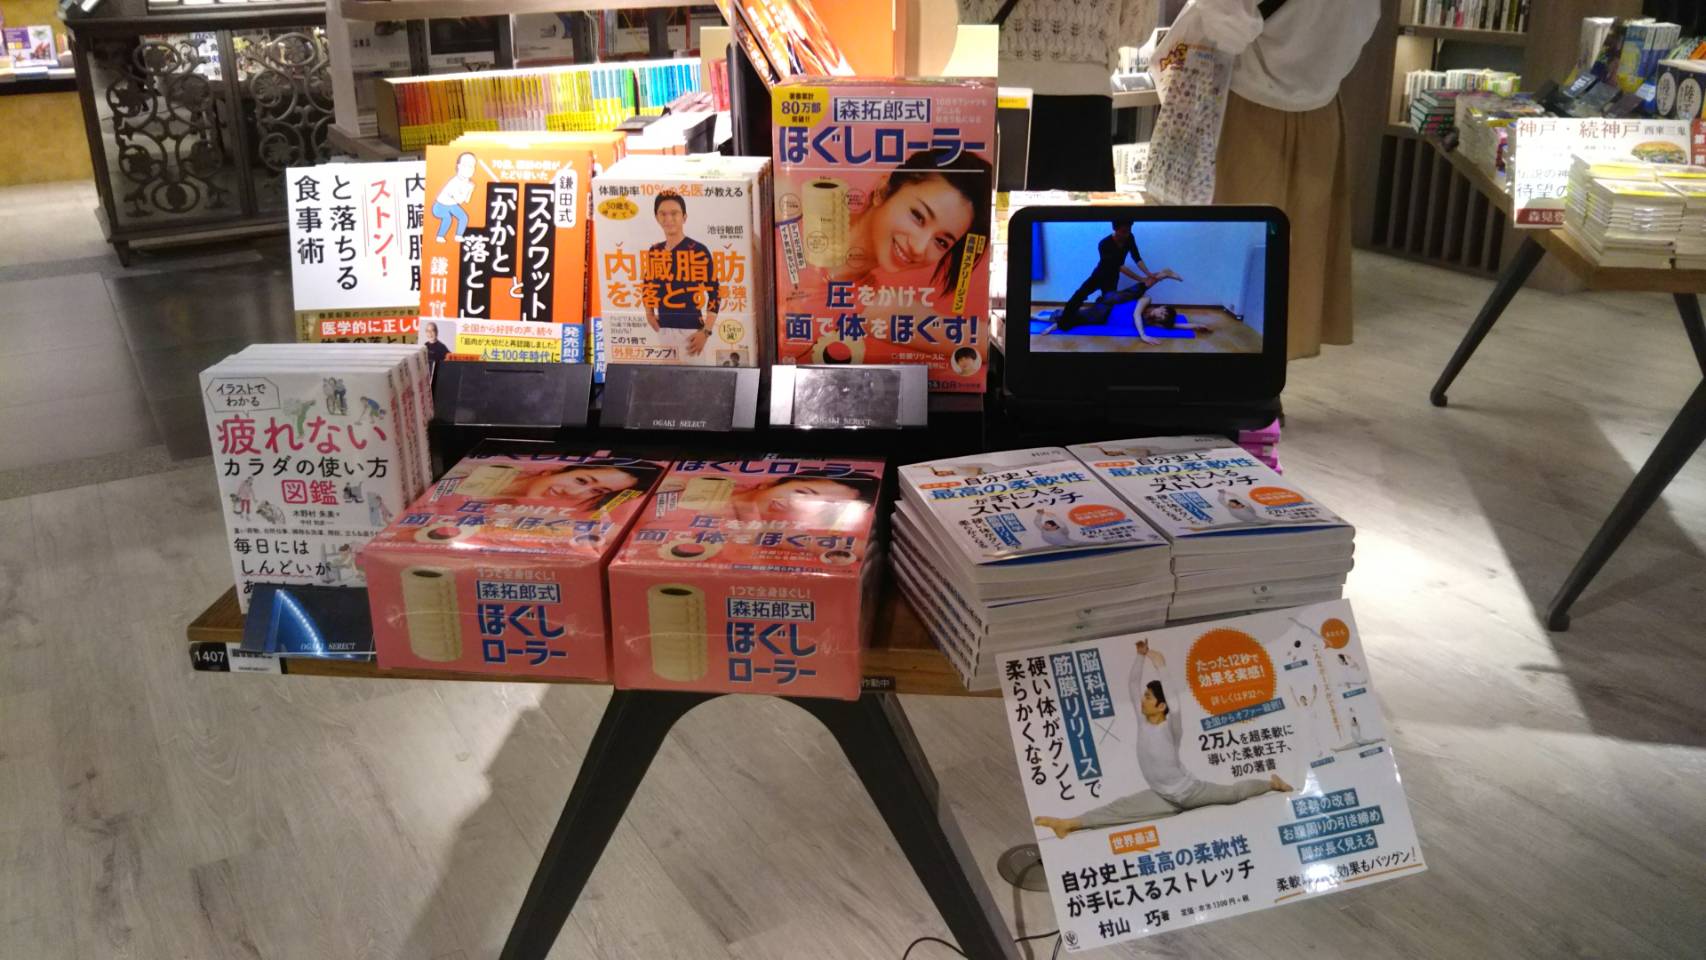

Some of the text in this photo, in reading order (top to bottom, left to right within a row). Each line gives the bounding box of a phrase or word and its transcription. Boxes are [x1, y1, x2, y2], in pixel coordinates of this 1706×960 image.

[781, 101, 821, 115] 80万部
[839, 100, 925, 121] 森拓郎式
[779, 126, 986, 166] ほぐしローラー
[558, 174, 575, 223] 鎌田式
[294, 175, 325, 265] 食事術
[370, 180, 395, 277] ストン!
[489, 187, 519, 273] 「かかと
[706, 225, 744, 235] 池谷敏郎
[329, 175, 358, 290] と落ちる
[603, 249, 747, 282] 内臓脂肪
[508, 276, 525, 299] と
[607, 282, 714, 310] を落とす
[826, 281, 936, 309] 圧をかけて
[785, 312, 979, 345] 面で体をほぐす!
[610, 336, 647, 345] この1冊で
[480, 348, 561, 363] 人生100年時代に
[216, 382, 267, 396] イラストで
[225, 395, 261, 408] わかる
[217, 415, 388, 455] 疲れない
[223, 456, 390, 479] カラダの使い方
[675, 459, 876, 478] ほぐしローラー
[1107, 457, 1262, 478] 最高の柔軟性
[1136, 452, 1212, 466] 自分史上
[931, 471, 1091, 501] 最高の柔軟性
[963, 468, 1042, 487] 自分史上
[1149, 475, 1260, 493] ストレッチ
[1152, 469, 1240, 483] が手に入る
[281, 479, 338, 505] 図鑑
[974, 486, 1066, 506] が手に入る
[457, 500, 577, 517] 圧をかけて
[968, 492, 1085, 516] ストレッチ
[398, 512, 615, 534] 面で体をほぐす!
[689, 514, 810, 531] 圧をかけて
[233, 537, 310, 556] 毎日には
[633, 528, 856, 551] 面で体をほぐす!
[241, 558, 331, 577] しんどいが
[477, 567, 557, 580] 1つで全身ほぐし!
[482, 583, 556, 601] 森拓郎式
[729, 585, 811, 598] 1つで全身ほぐし!
[477, 603, 565, 638] ほぐし
[732, 600, 809, 619] 森拓郎式
[726, 622, 817, 657] ほぐし
[194, 650, 225, 663] 1407
[482, 639, 568, 666] ローラー
[1195, 652, 1260, 671] たった12秒で
[727, 657, 817, 684] ローラー
[1198, 665, 1265, 688] 効果を実感!
[1079, 651, 1111, 716] 脳科学
[1005, 659, 1047, 786] 柔らかくなる
[1026, 656, 1076, 802] 硬い体がグンと
[1052, 655, 1102, 799] 筋膜リリースで
[1198, 724, 1295, 752] 2万人を超柔軟に
[1207, 742, 1293, 766] 導いた柔軟王子、
[1231, 758, 1277, 778] 初の著書
[1295, 791, 1358, 816] 姿勢の改善
[1282, 810, 1381, 841] お腹周りの引き締め
[1111, 830, 1158, 850] 世界最速
[1061, 834, 1252, 894] 自分史上最高の柔軟性
[1275, 848, 1417, 893] 柔軟効果もバツグン!
[1067, 859, 1256, 918] が手に入るストレッチ
[1098, 916, 1132, 940] 村山
